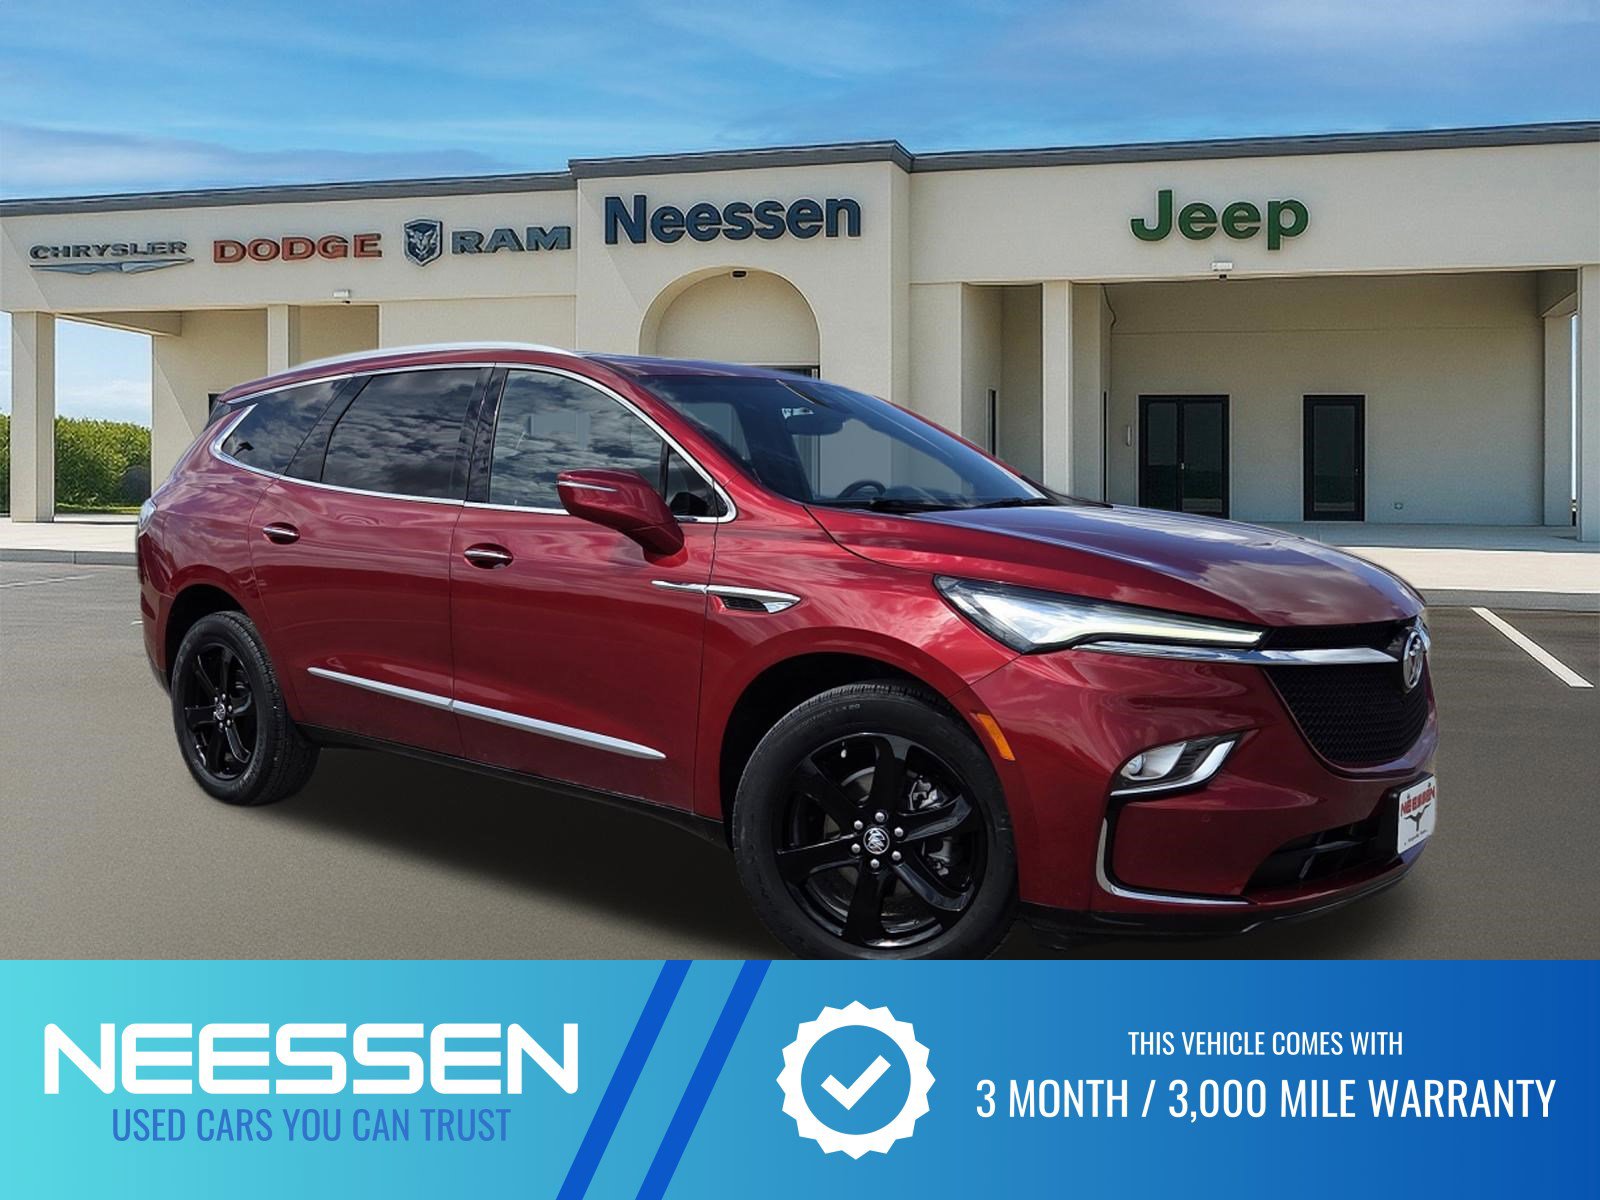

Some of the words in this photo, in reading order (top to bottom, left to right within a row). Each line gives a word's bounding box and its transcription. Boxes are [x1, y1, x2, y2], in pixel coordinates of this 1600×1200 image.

[604, 194, 861, 245] Neessen
[1130, 189, 1309, 250] Jeep
[29, 241, 188, 259] CHRYSLER
[213, 233, 382, 263] DODGE
[452, 226, 571, 254] RAM
